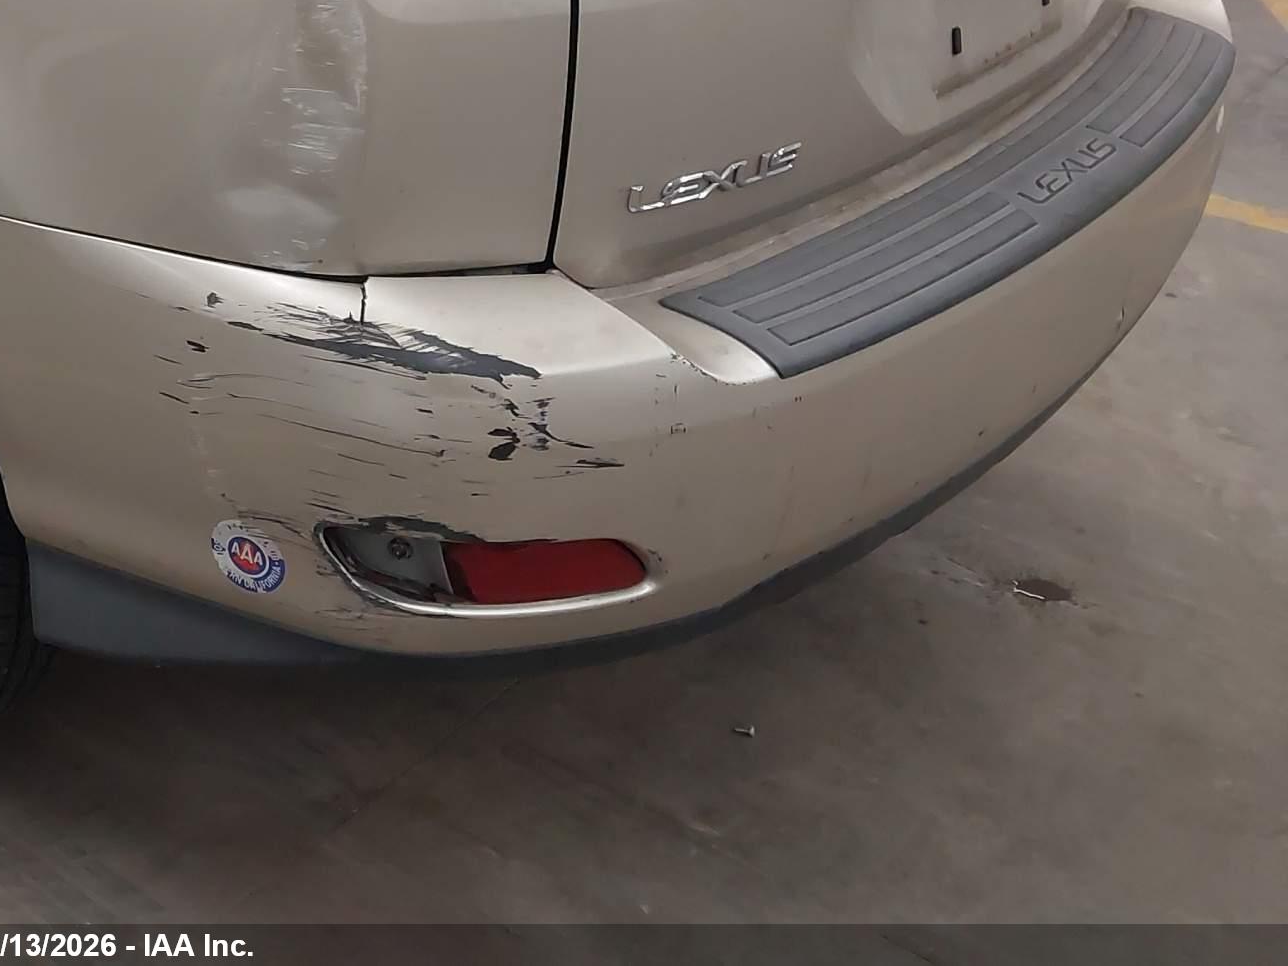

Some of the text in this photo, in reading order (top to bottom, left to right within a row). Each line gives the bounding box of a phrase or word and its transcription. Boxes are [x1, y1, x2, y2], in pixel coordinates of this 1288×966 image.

[626, 141, 803, 214] LEXUS
[1017, 136, 1117, 205] LEXUS
[231, 541, 264, 566] AAA
